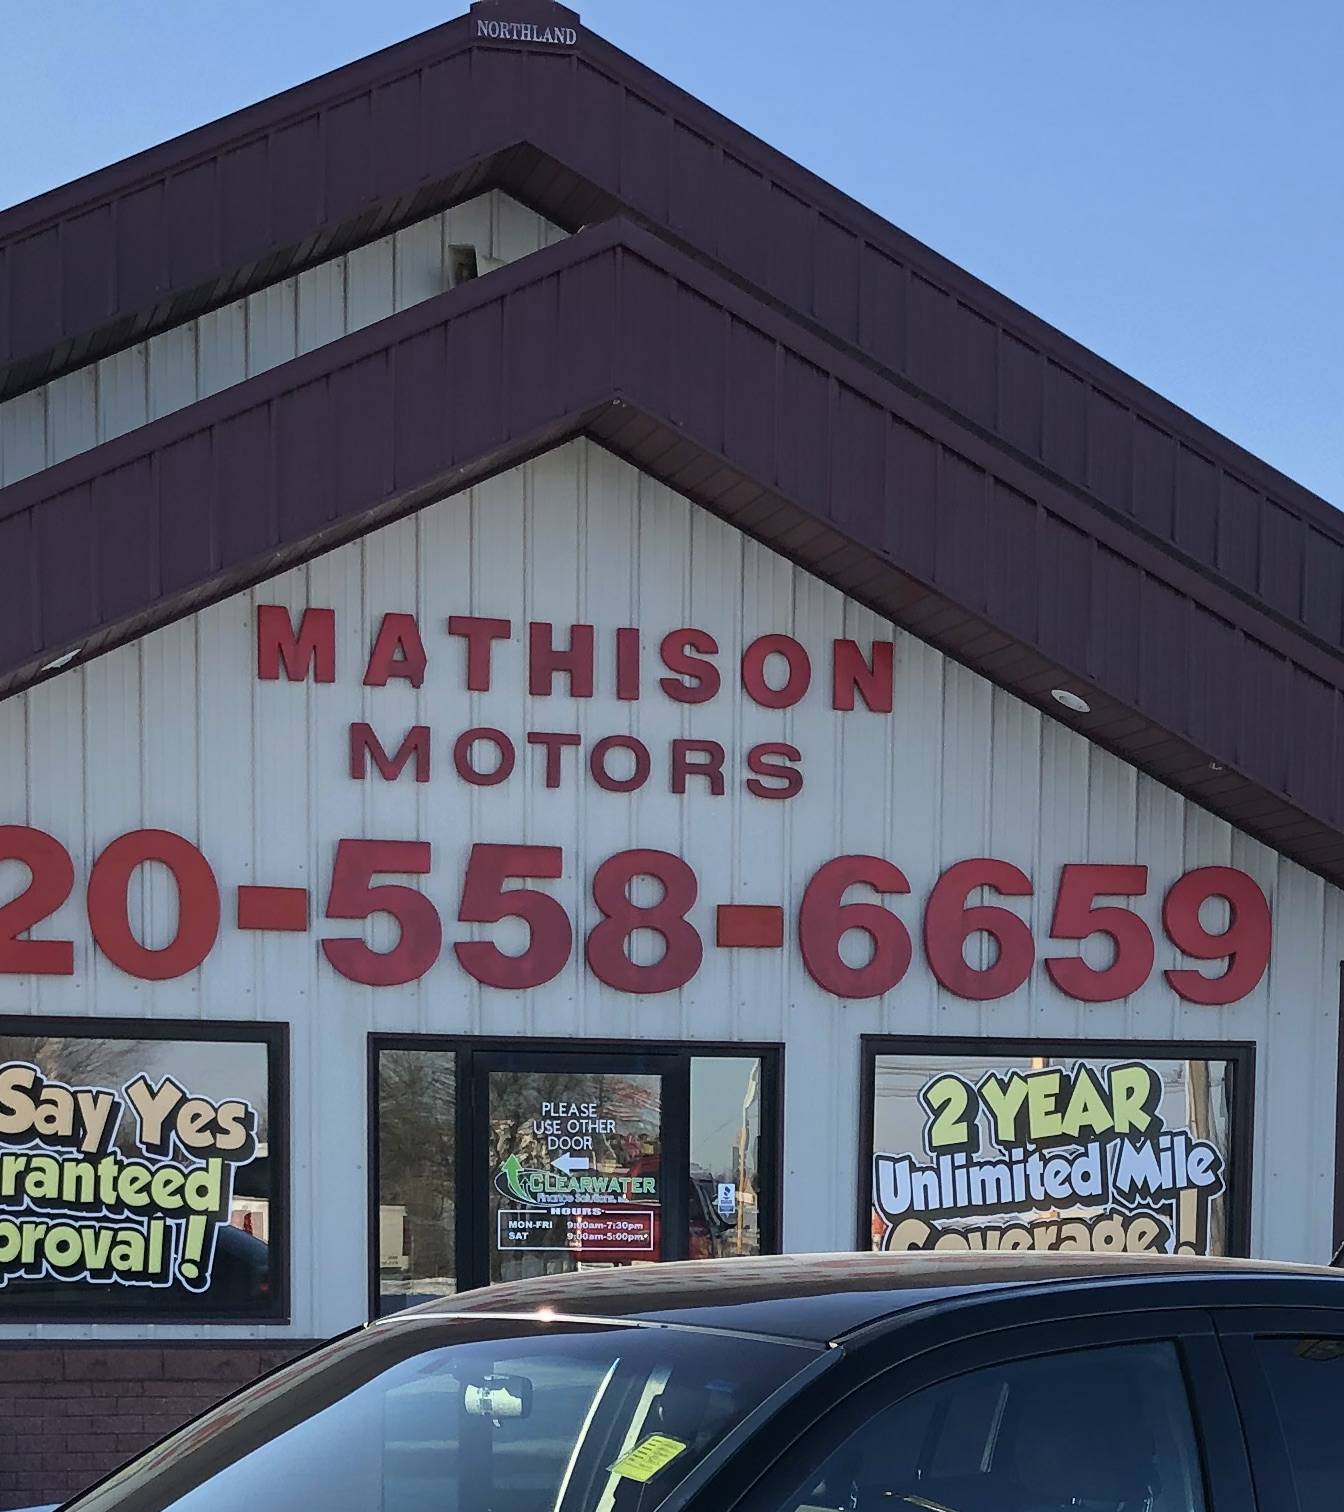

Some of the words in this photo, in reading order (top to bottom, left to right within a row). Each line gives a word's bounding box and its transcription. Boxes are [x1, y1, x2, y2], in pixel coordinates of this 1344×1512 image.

[477, 19, 577, 45] NORTHLAND
[257, 604, 894, 713] MATHISON
[349, 722, 805, 800] MOTORS
[126, 1075, 248, 1151] Yes
[541, 1101, 598, 1118] PLEASE
[926, 1076, 969, 1148] 2
[979, 1066, 1152, 1142] YEAR
[533, 1120, 562, 1135] USE
[566, 1119, 616, 1134] OTHER
[547, 1136, 593, 1151] DOOR
[529, 1173, 656, 1194] CLEARWATER
[877, 1141, 1103, 1215] Unlimited
[1114, 1134, 1225, 1195] Mile
[550, 1207, 602, 1216] HOURS
[508, 1220, 553, 1230] MON-FRI
[567, 1221, 644, 1231] 9:00am-7:30pm
[508, 1231, 529, 1241] SAT
